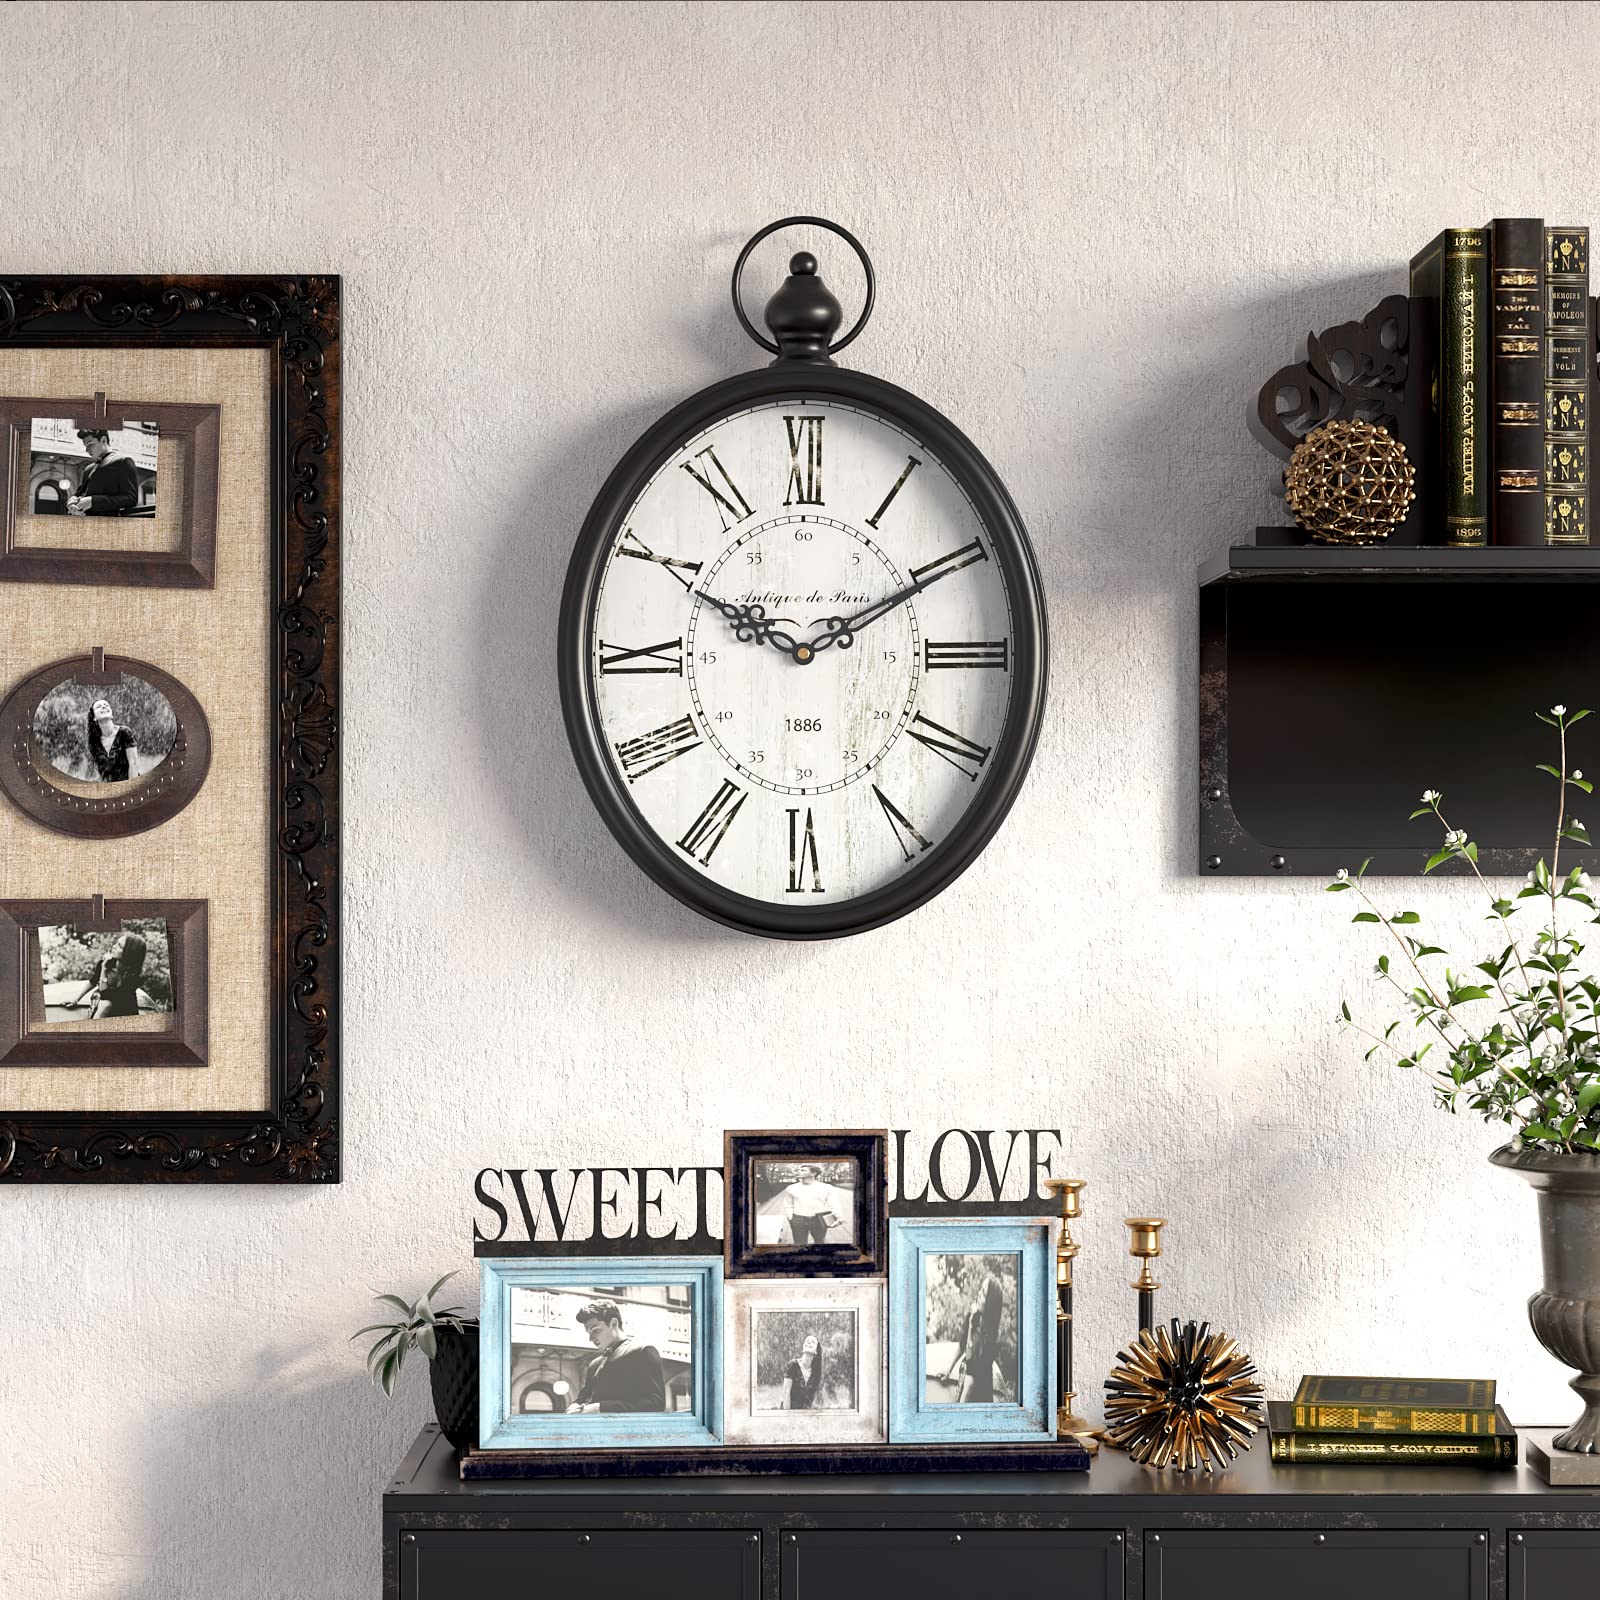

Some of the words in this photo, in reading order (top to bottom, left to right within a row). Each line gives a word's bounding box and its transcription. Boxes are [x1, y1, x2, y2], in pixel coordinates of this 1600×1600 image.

[1454, 237, 1482, 247] 1796
[1561, 256, 1570, 270] N
[1548, 311, 1584, 319] NAPOLEON
[1460, 289, 1474, 374] НИКОЛАЙ
[1561, 413, 1569, 428] N
[783, 416, 825, 506] XII
[1561, 466, 1569, 480] N
[679, 444, 757, 533] XI
[1561, 517, 1569, 532] N
[794, 529, 813, 541] 60
[1456, 528, 1482, 537] 1896
[615, 528, 703, 592] X
[746, 552, 762, 565] 55
[852, 553, 860, 566] 5
[735, 588, 801, 608] Antique
[806, 589, 824, 603] de
[829, 589, 870, 604] Paris
[699, 652, 717, 665] 45
[882, 651, 897, 664] 15
[925, 637, 1008, 673] III
[714, 711, 733, 723] 40
[873, 710, 890, 720] 20
[785, 718, 822, 732] 1886
[748, 750, 764, 763] 35
[842, 750, 858, 763] 25
[796, 768, 813, 781] 30
[891, 1128, 1062, 1202] LOVE
[473, 1167, 724, 1242] SWEET
